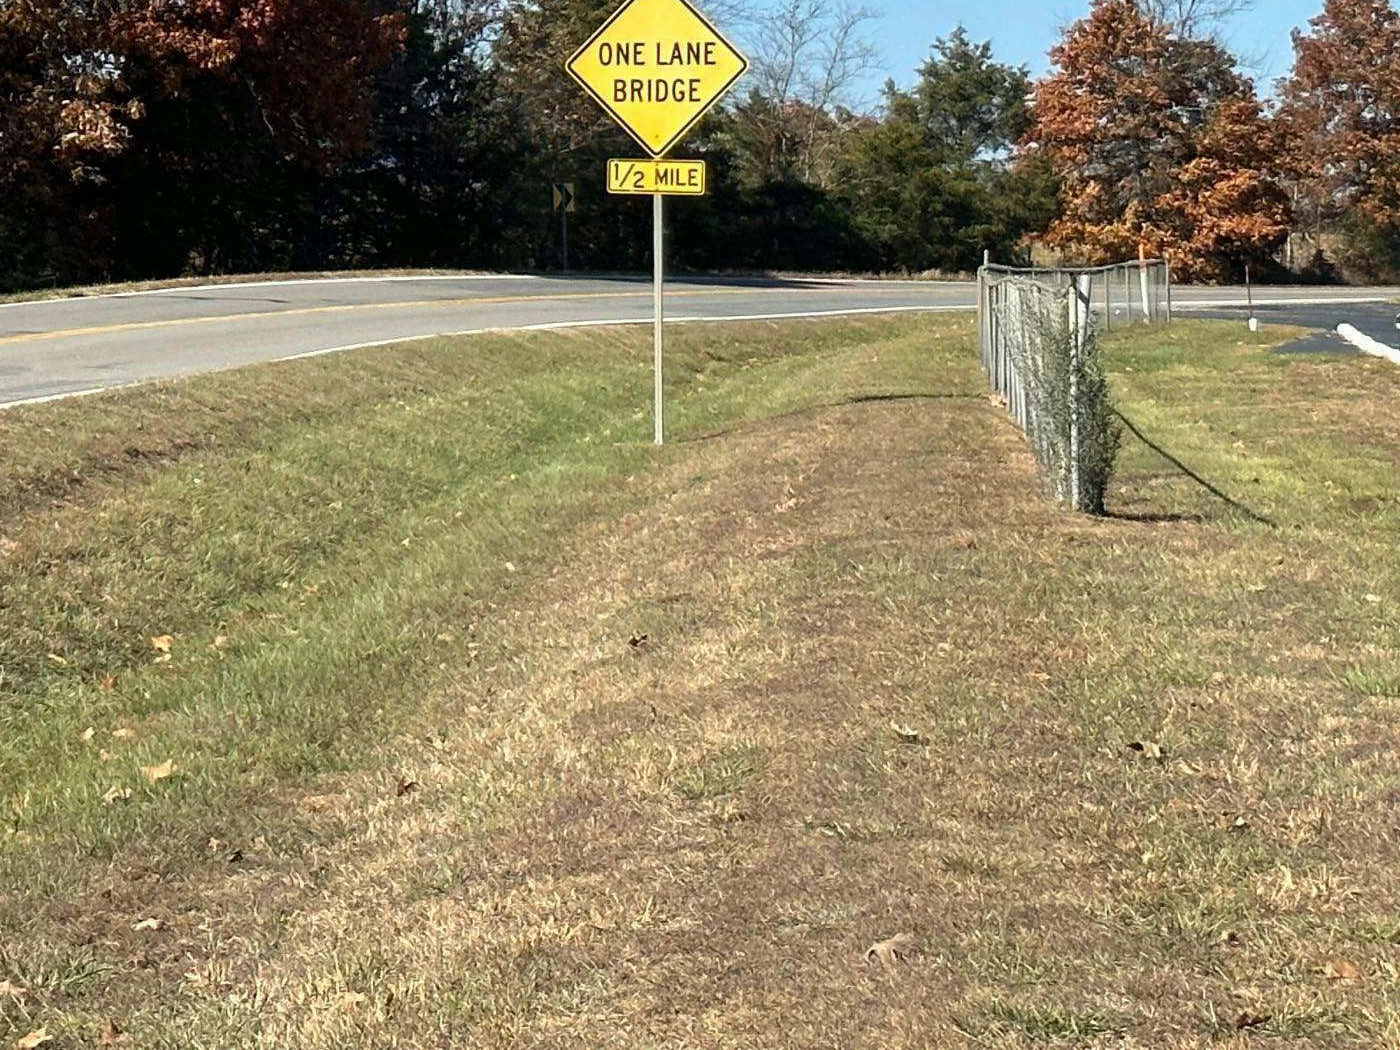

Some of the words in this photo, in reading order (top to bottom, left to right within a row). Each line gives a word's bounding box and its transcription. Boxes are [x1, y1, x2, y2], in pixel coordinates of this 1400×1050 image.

[599, 42, 646, 66] ONE
[656, 41, 717, 65] LANE
[613, 79, 701, 102] BRIDGE
[614, 163, 645, 188] 1/2
[654, 168, 698, 186] MILE
